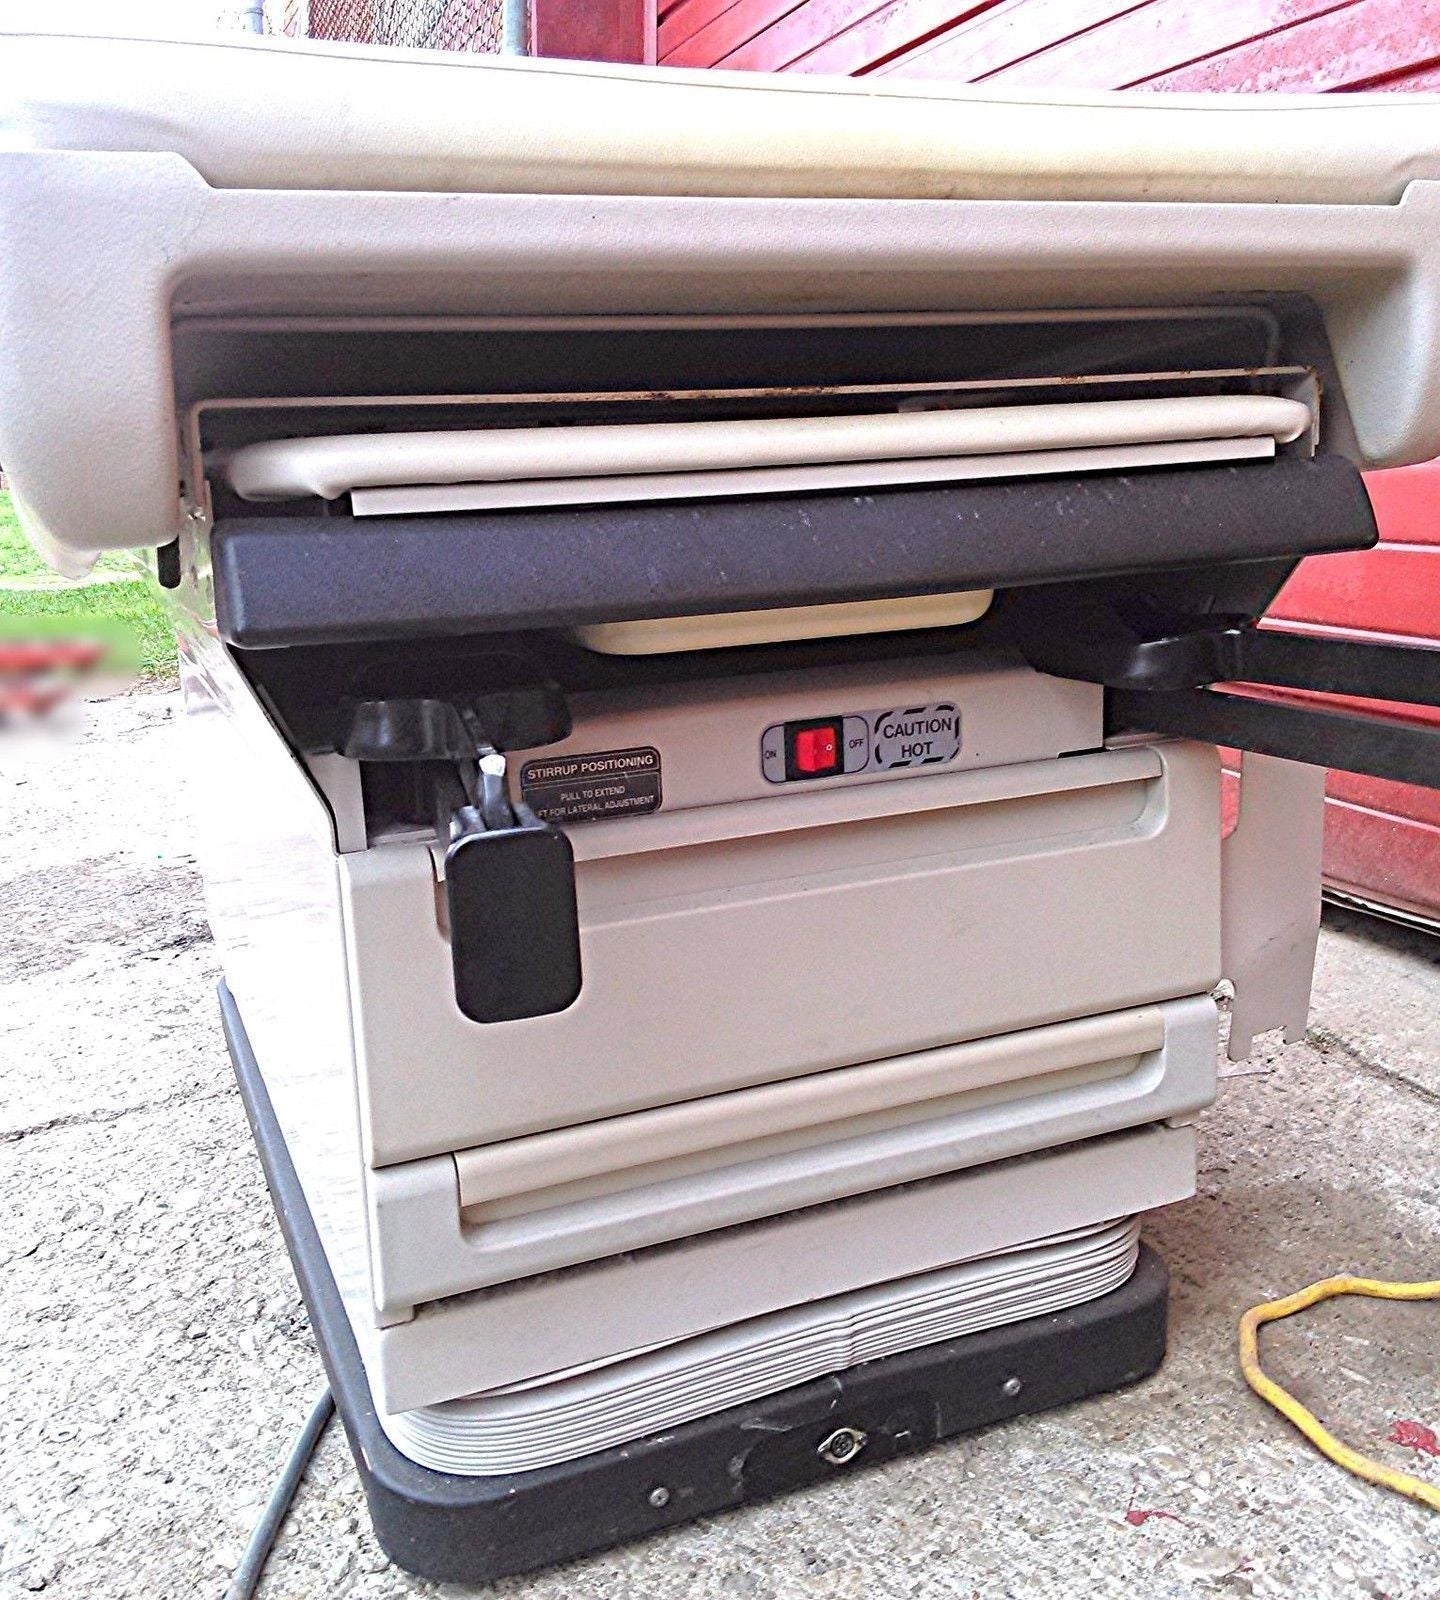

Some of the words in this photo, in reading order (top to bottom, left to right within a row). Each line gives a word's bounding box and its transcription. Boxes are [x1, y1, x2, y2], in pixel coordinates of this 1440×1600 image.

[883, 718, 951, 739] CAUTION
[849, 738, 864, 749] OFF
[901, 741, 933, 758] HOT
[764, 750, 777, 760] ON
[527, 764, 578, 779] STIRRUP
[581, 755, 653, 772] POSITIONING
[561, 792, 580, 801] PULL
[582, 790, 593, 798] TO
[594, 785, 626, 797] EXTEND
[549, 807, 566, 817] FOR
[567, 801, 603, 815] LATERAL
[604, 795, 654, 809] ADJUSTMENT
